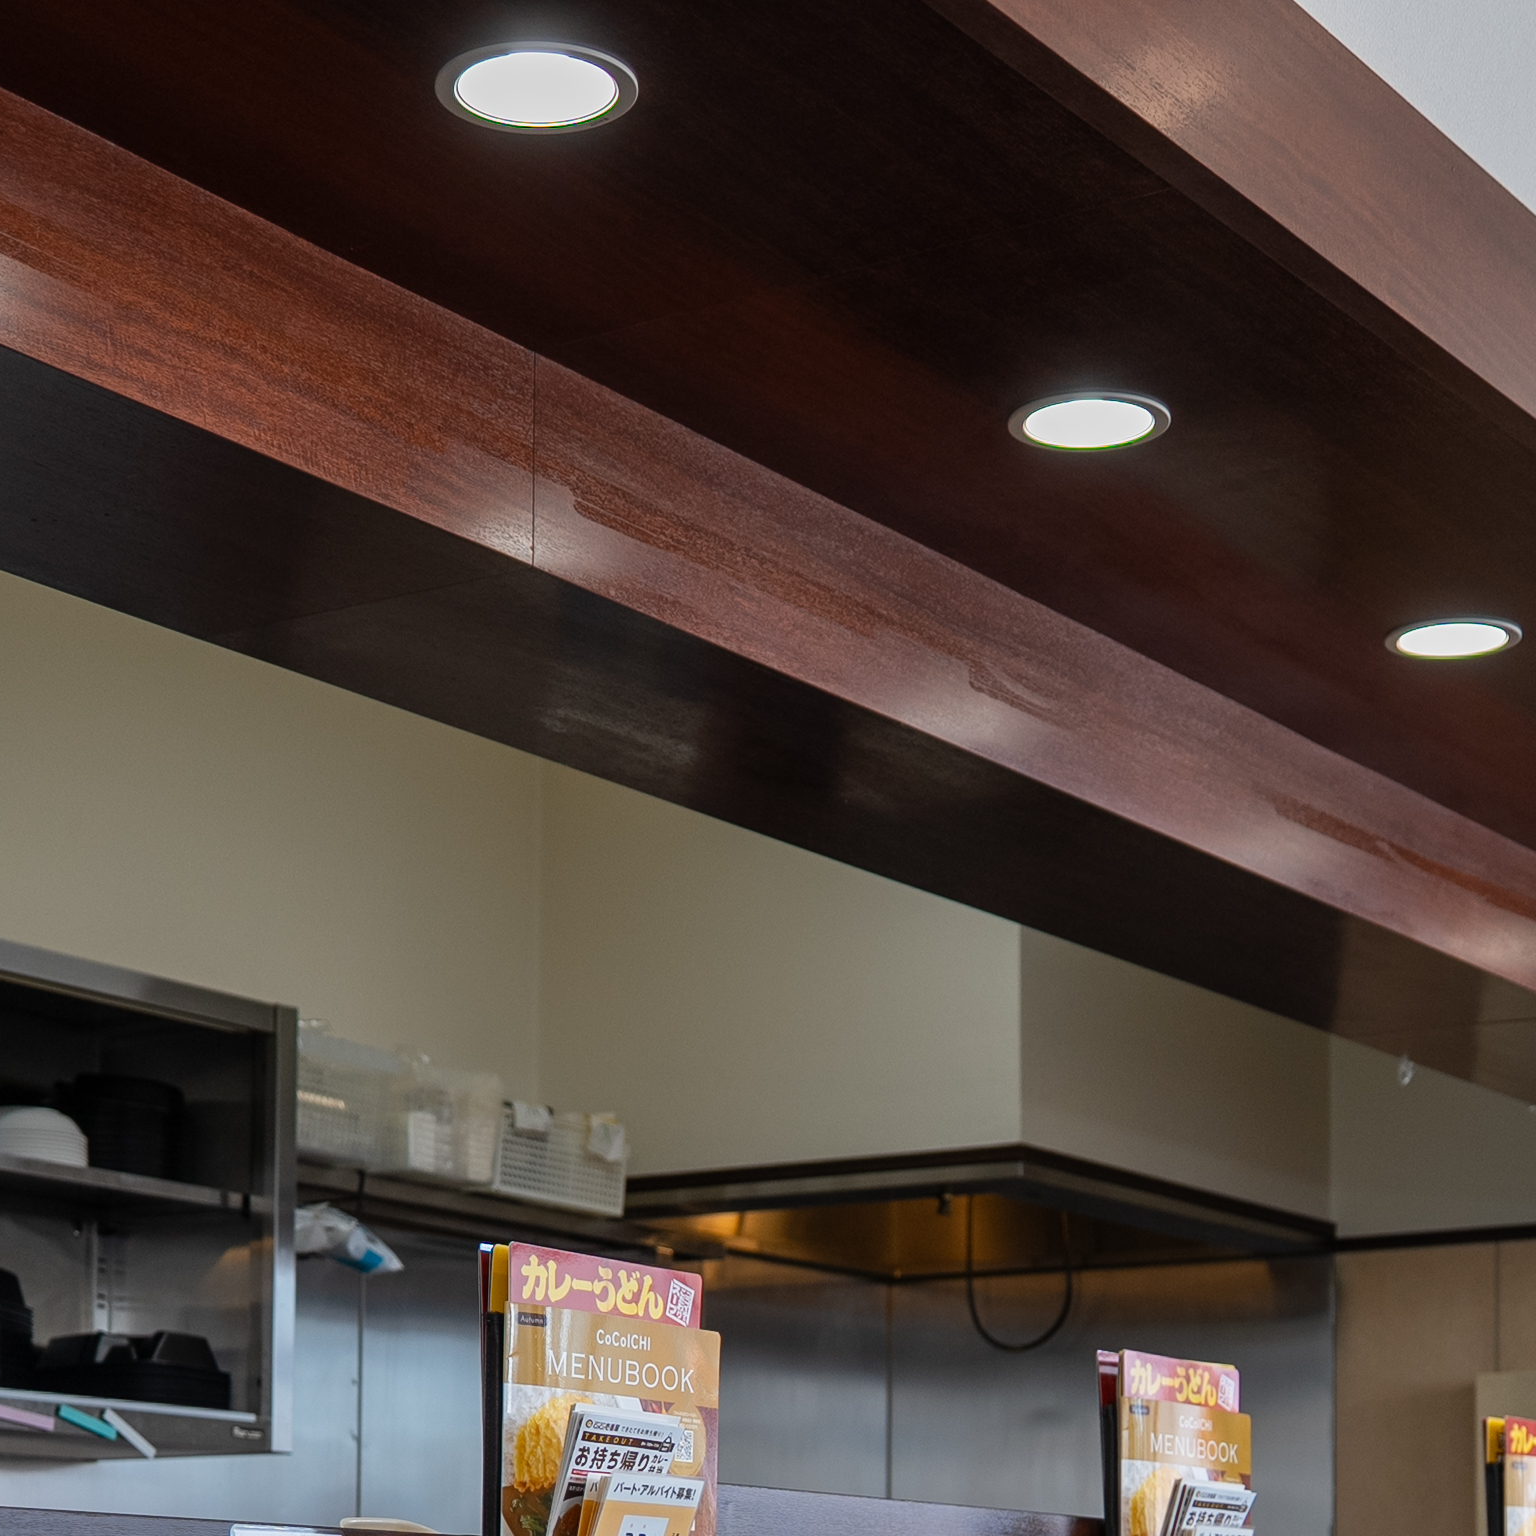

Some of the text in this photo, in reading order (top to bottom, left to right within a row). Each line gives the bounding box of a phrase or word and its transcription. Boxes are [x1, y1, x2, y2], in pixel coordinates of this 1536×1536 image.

[521, 1254, 665, 1320] カレーうどん
[596, 1329, 652, 1351] CoCoICHI
[547, 1350, 695, 1394] MENUBOOK
[1130, 1359, 1217, 1407] カレーうどん
[584, 1433, 634, 1445] TAKE OUT
[1150, 1432, 1239, 1465] MENUBOOK
[574, 1447, 650, 1471] お持ち帰り
[651, 1454, 668, 1464] カレー
